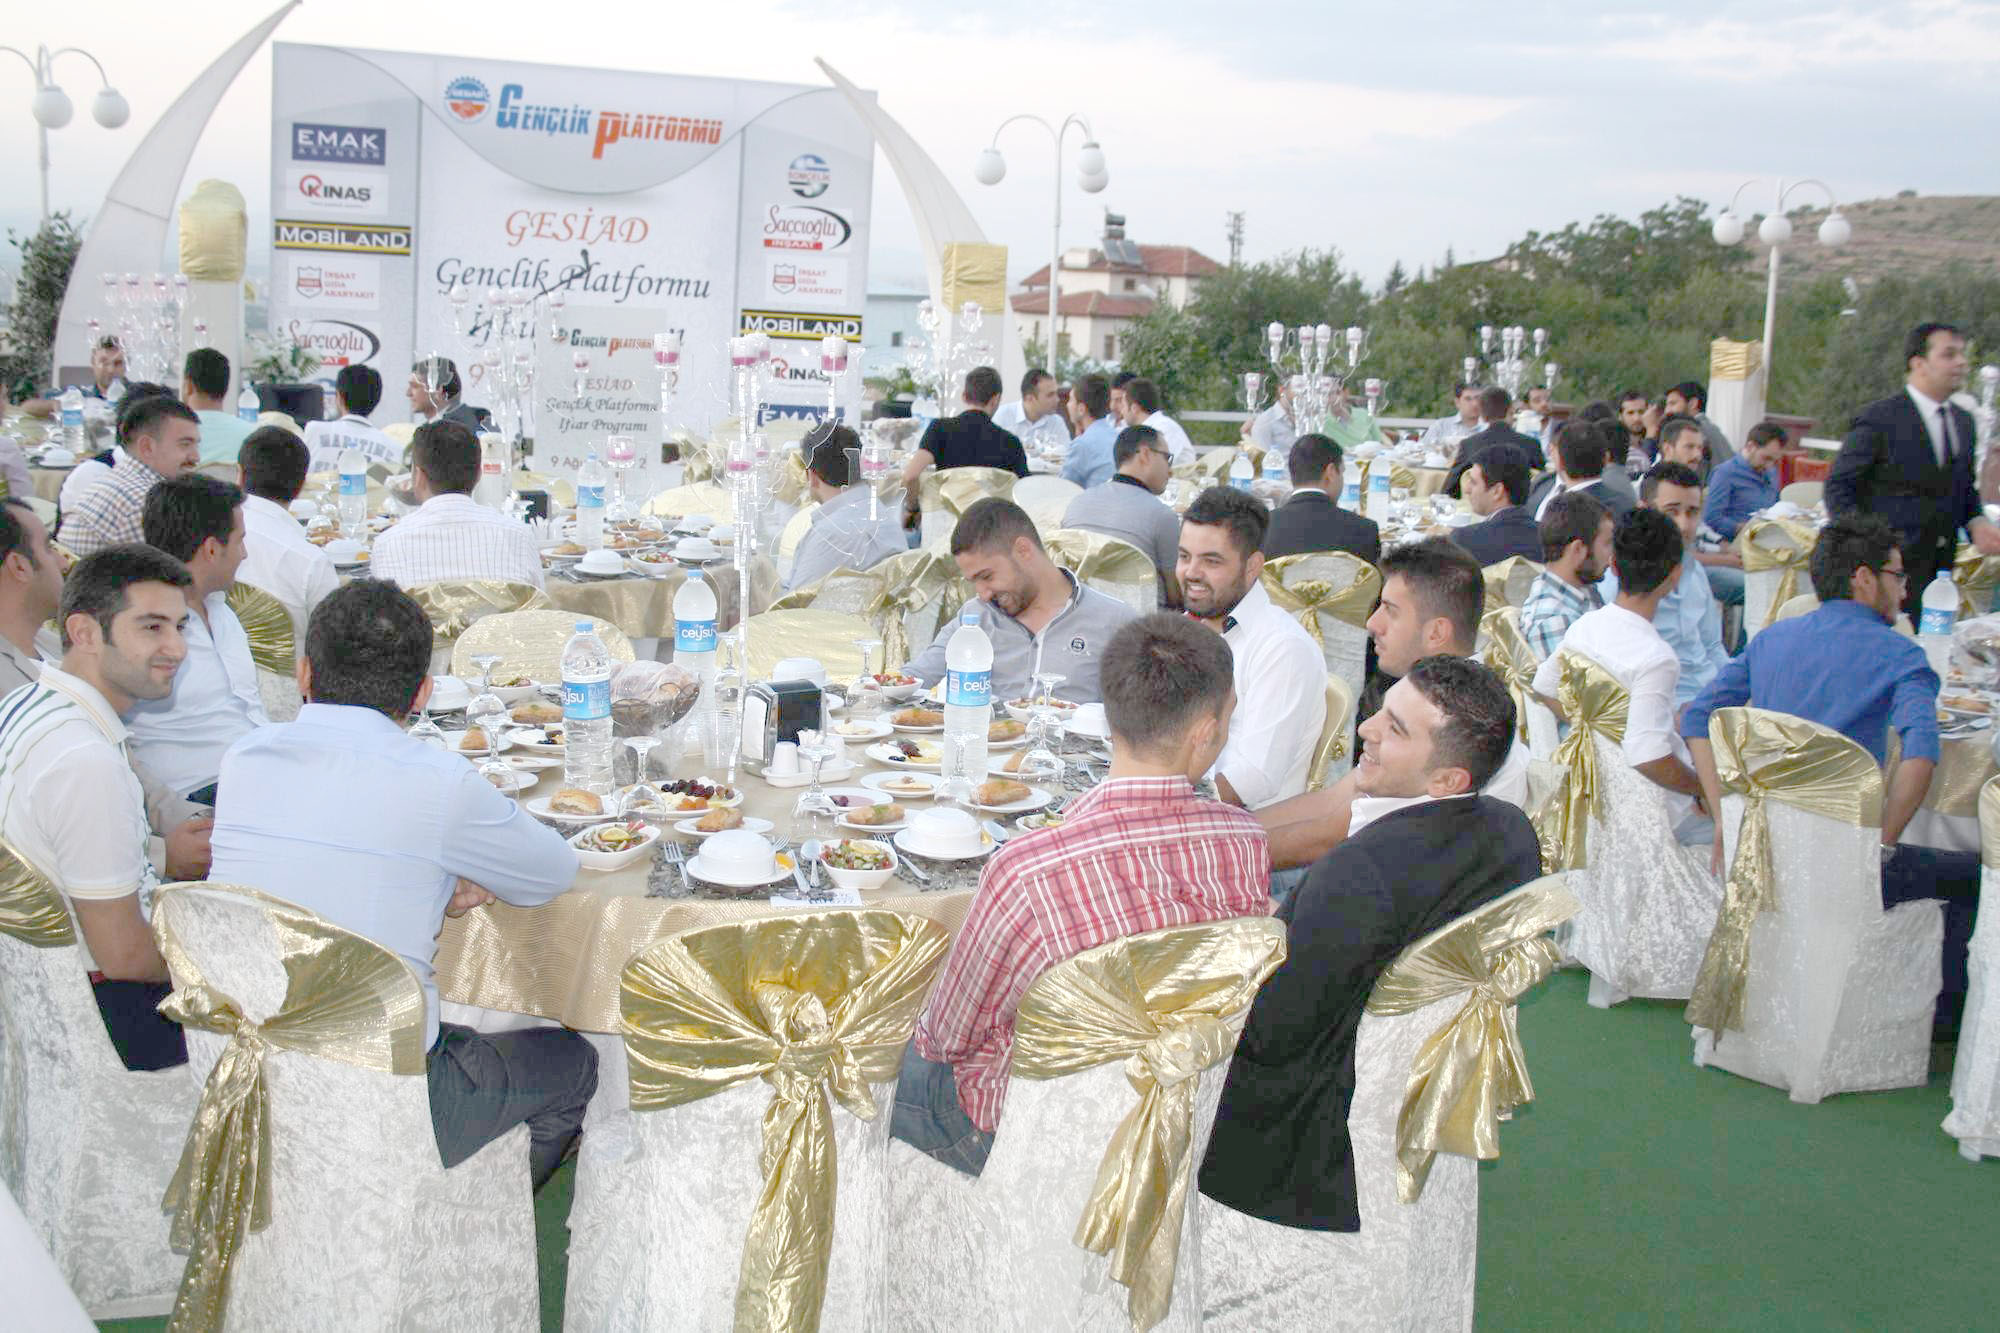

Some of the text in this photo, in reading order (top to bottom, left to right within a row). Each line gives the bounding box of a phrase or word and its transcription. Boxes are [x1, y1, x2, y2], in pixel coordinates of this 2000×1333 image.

[298, 128, 378, 150] EMAK
[505, 207, 648, 246] GESİAD
[560, 262, 711, 303] Platformu
